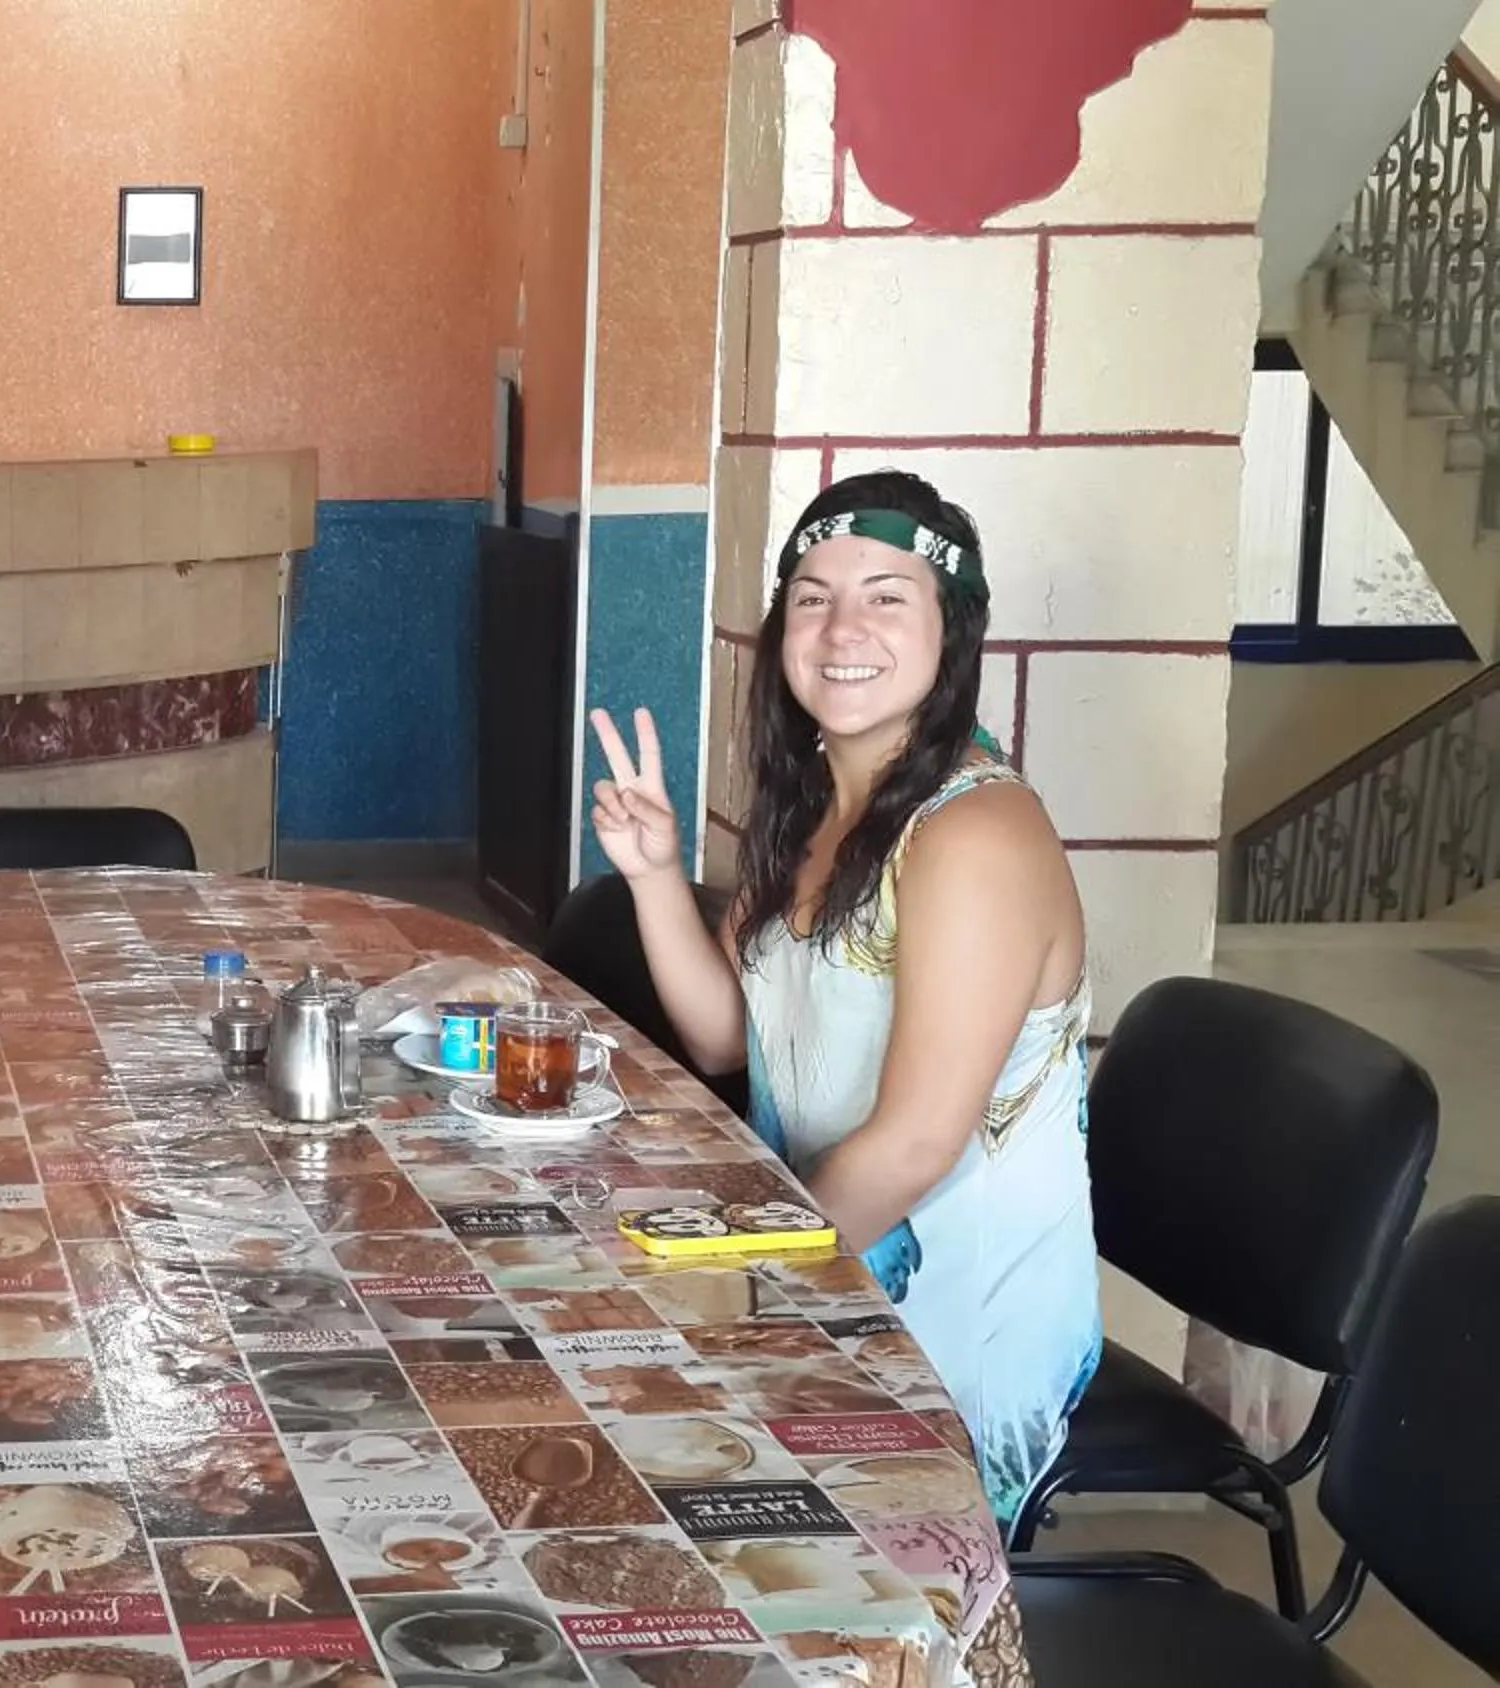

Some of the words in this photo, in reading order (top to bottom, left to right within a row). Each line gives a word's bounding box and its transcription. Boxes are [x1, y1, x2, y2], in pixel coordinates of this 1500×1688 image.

[690, 1499, 812, 1517] LATTE
[10, 1596, 122, 1628] protein
[632, 1612, 739, 1628] Chocolate
[568, 1616, 623, 1633] Cake
[576, 1630, 663, 1646] Amazing
[664, 1628, 715, 1644] Most
[714, 1626, 758, 1641] The
